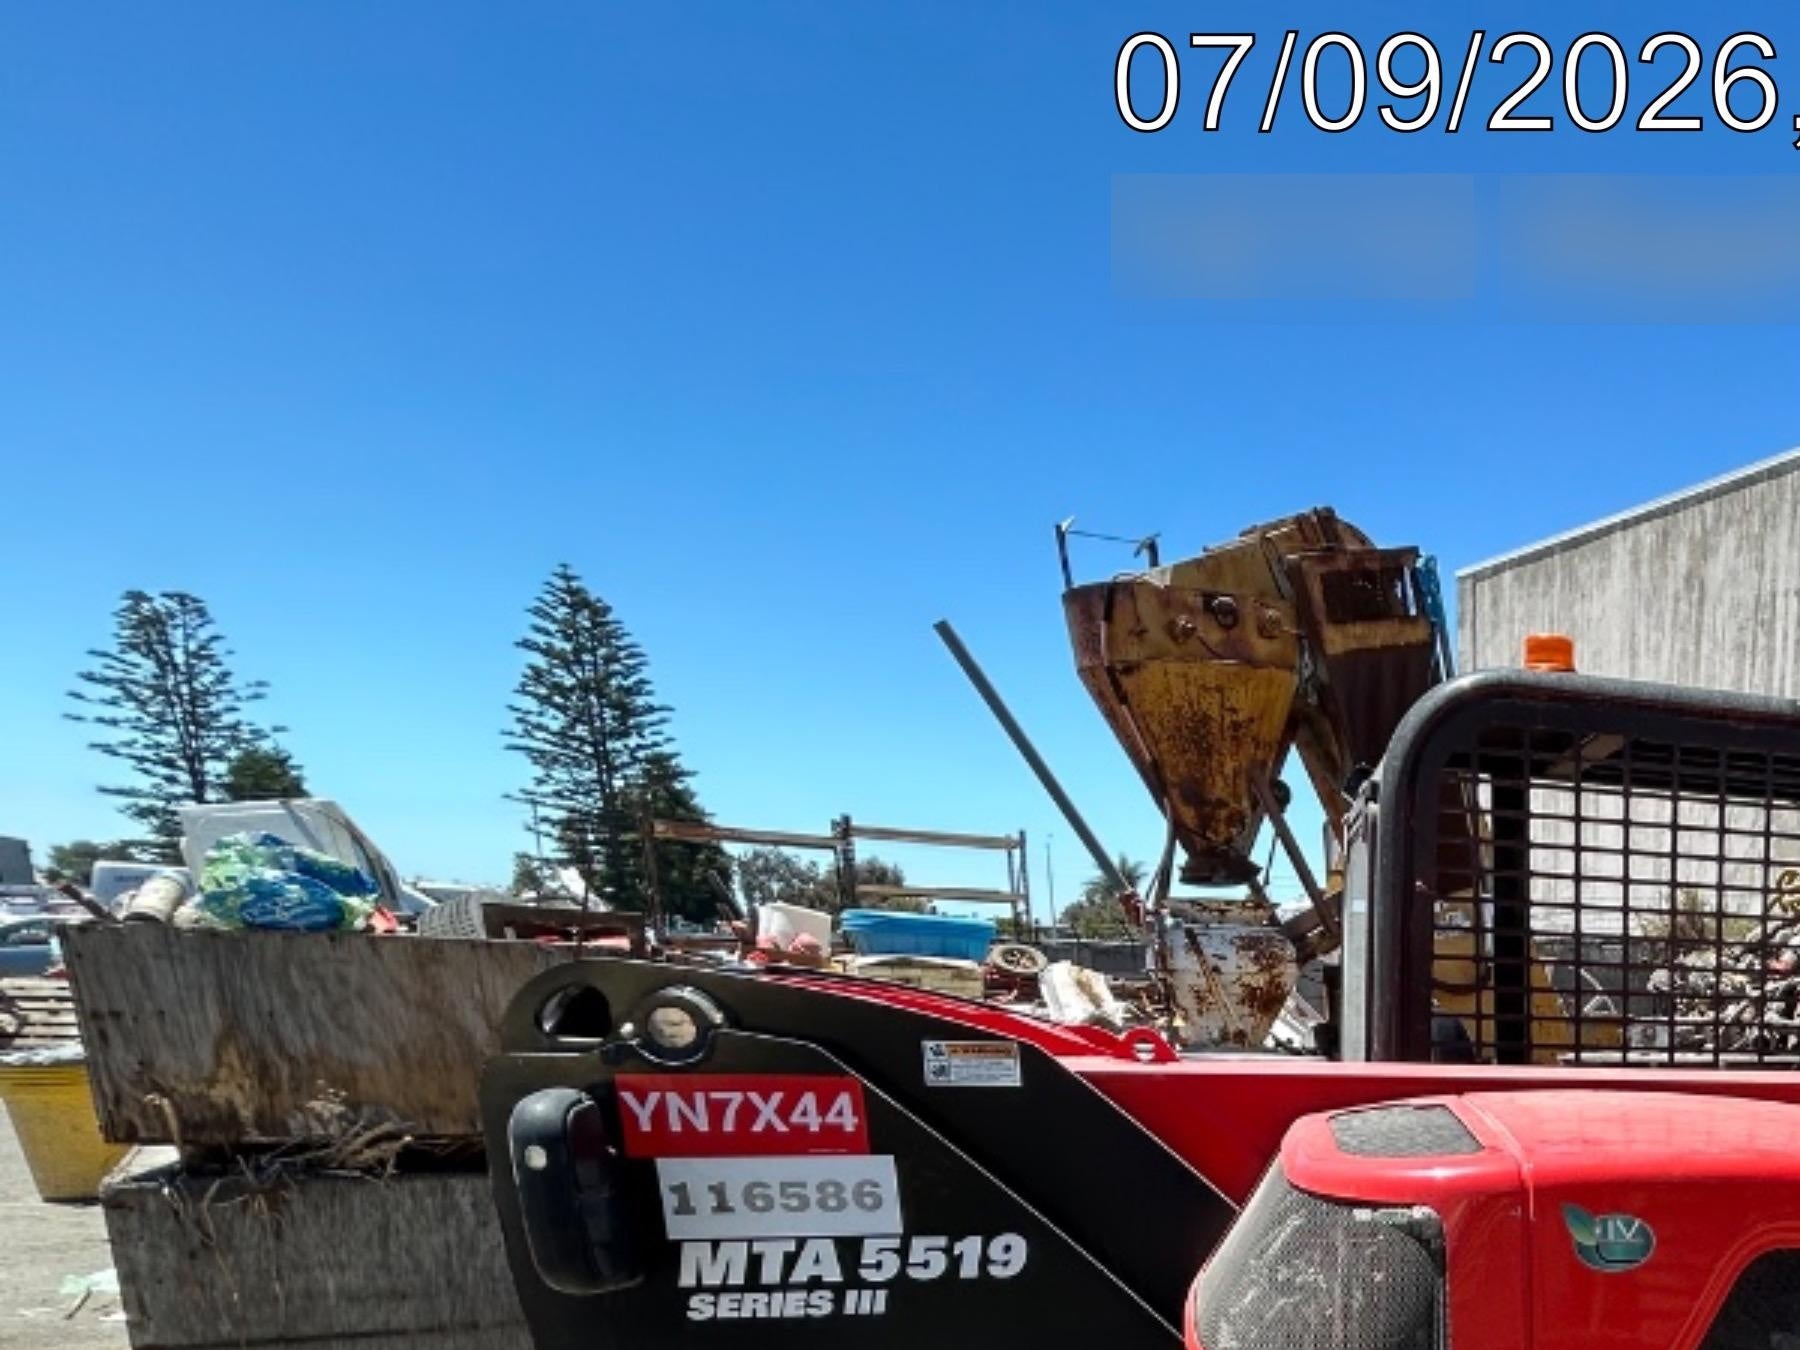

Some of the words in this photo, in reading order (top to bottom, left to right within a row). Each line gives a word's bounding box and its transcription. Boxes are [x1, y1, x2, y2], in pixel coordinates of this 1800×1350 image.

[619, 1091, 859, 1132] YN7X44
[668, 1179, 883, 1215] 116586
[678, 1238, 844, 1288] MTA
[858, 1232, 1028, 1282] 5519
[686, 1289, 835, 1321] SERIES
[843, 1289, 888, 1316] III
